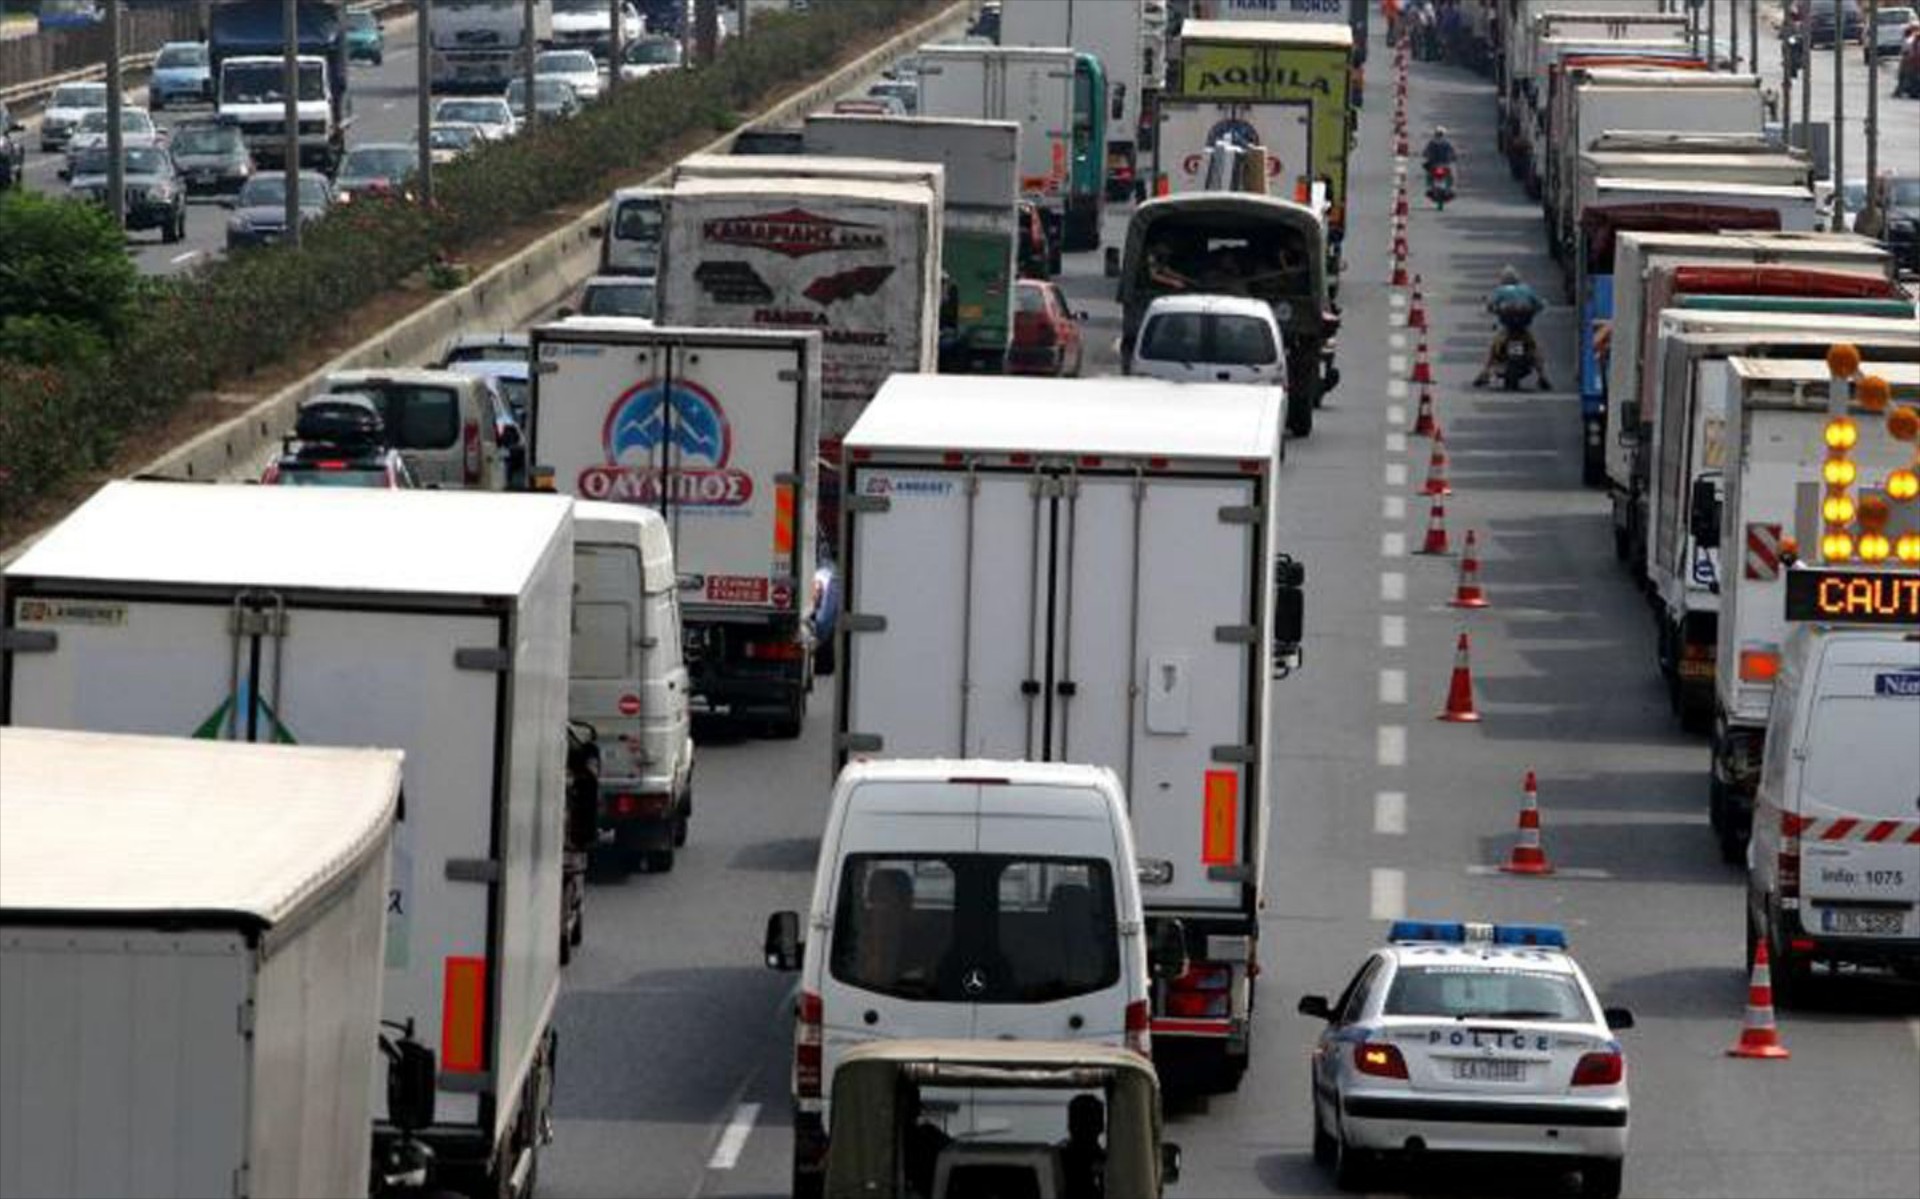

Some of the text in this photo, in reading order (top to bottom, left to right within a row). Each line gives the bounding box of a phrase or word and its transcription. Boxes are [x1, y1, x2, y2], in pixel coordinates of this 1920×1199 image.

[1198, 65, 1332, 95] AQUILA
[583, 471, 743, 500] ΟΛΥΜΠΟΣ
[1818, 577, 1920, 614] CAUT
[1865, 870, 1904, 887] 1075
[1428, 1030, 1549, 1051] POLICE
